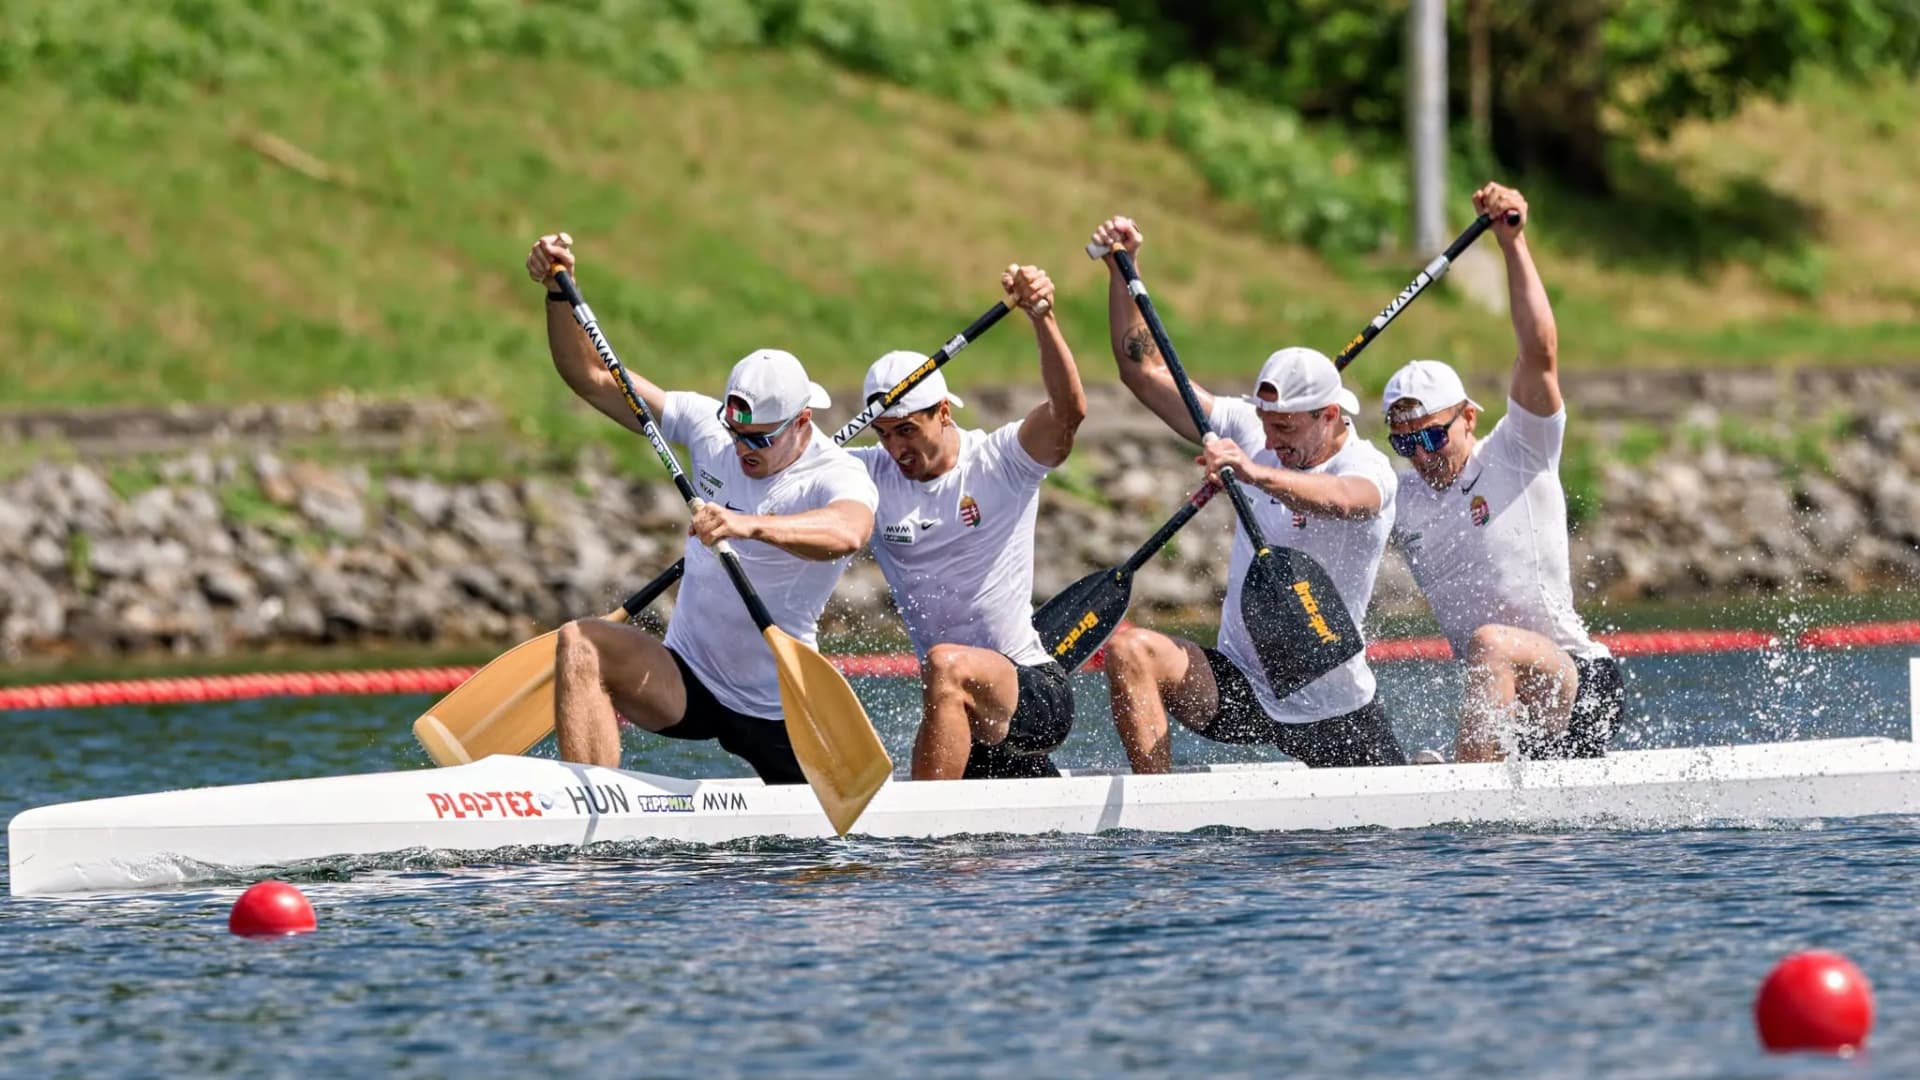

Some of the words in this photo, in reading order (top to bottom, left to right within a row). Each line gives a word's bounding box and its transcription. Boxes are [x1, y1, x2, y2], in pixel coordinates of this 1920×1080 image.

[1380, 279, 1419, 318] MVM
[586, 325, 616, 368] MVM
[886, 525, 911, 534] MVM
[565, 784, 630, 814] HUN
[703, 792, 748, 810] MVM
